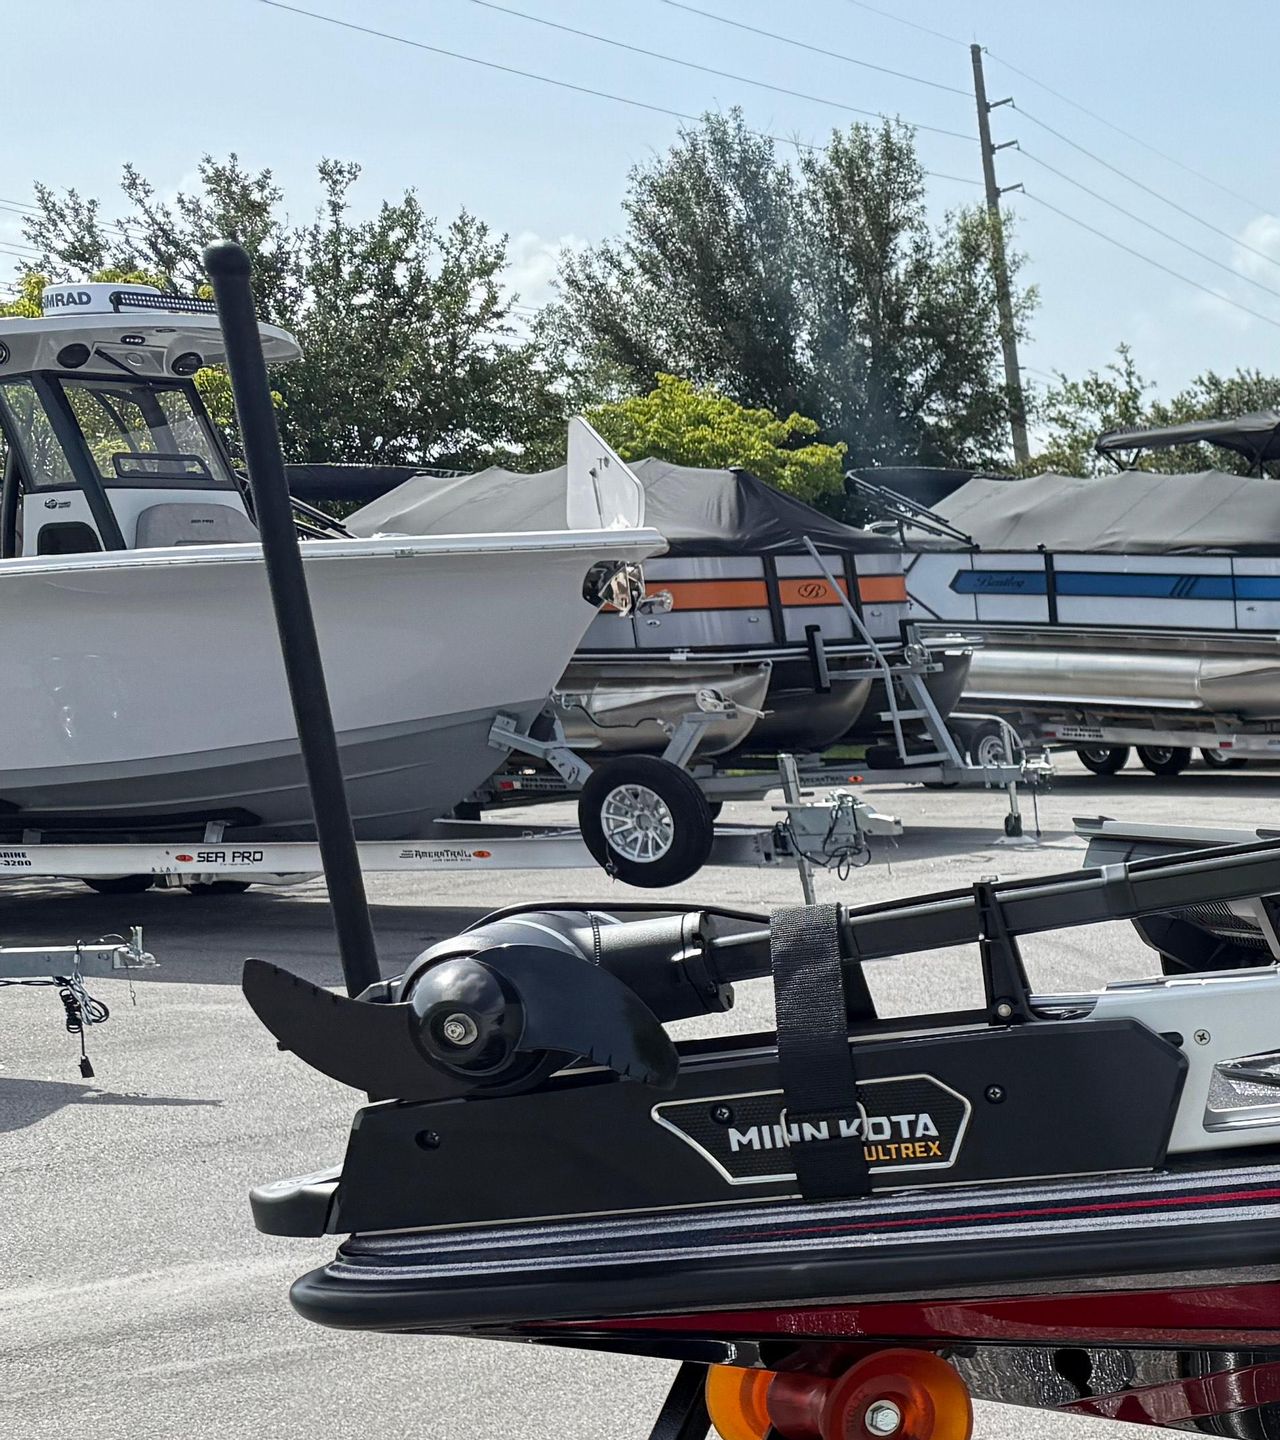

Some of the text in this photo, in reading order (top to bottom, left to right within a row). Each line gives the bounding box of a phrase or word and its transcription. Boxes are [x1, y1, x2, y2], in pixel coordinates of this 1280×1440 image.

[43, 291, 92, 308] MRAD
[197, 851, 264, 864] SEA PRO
[728, 1113, 940, 1152] MINN KOTA
[863, 1140, 943, 1161] ULTREX
